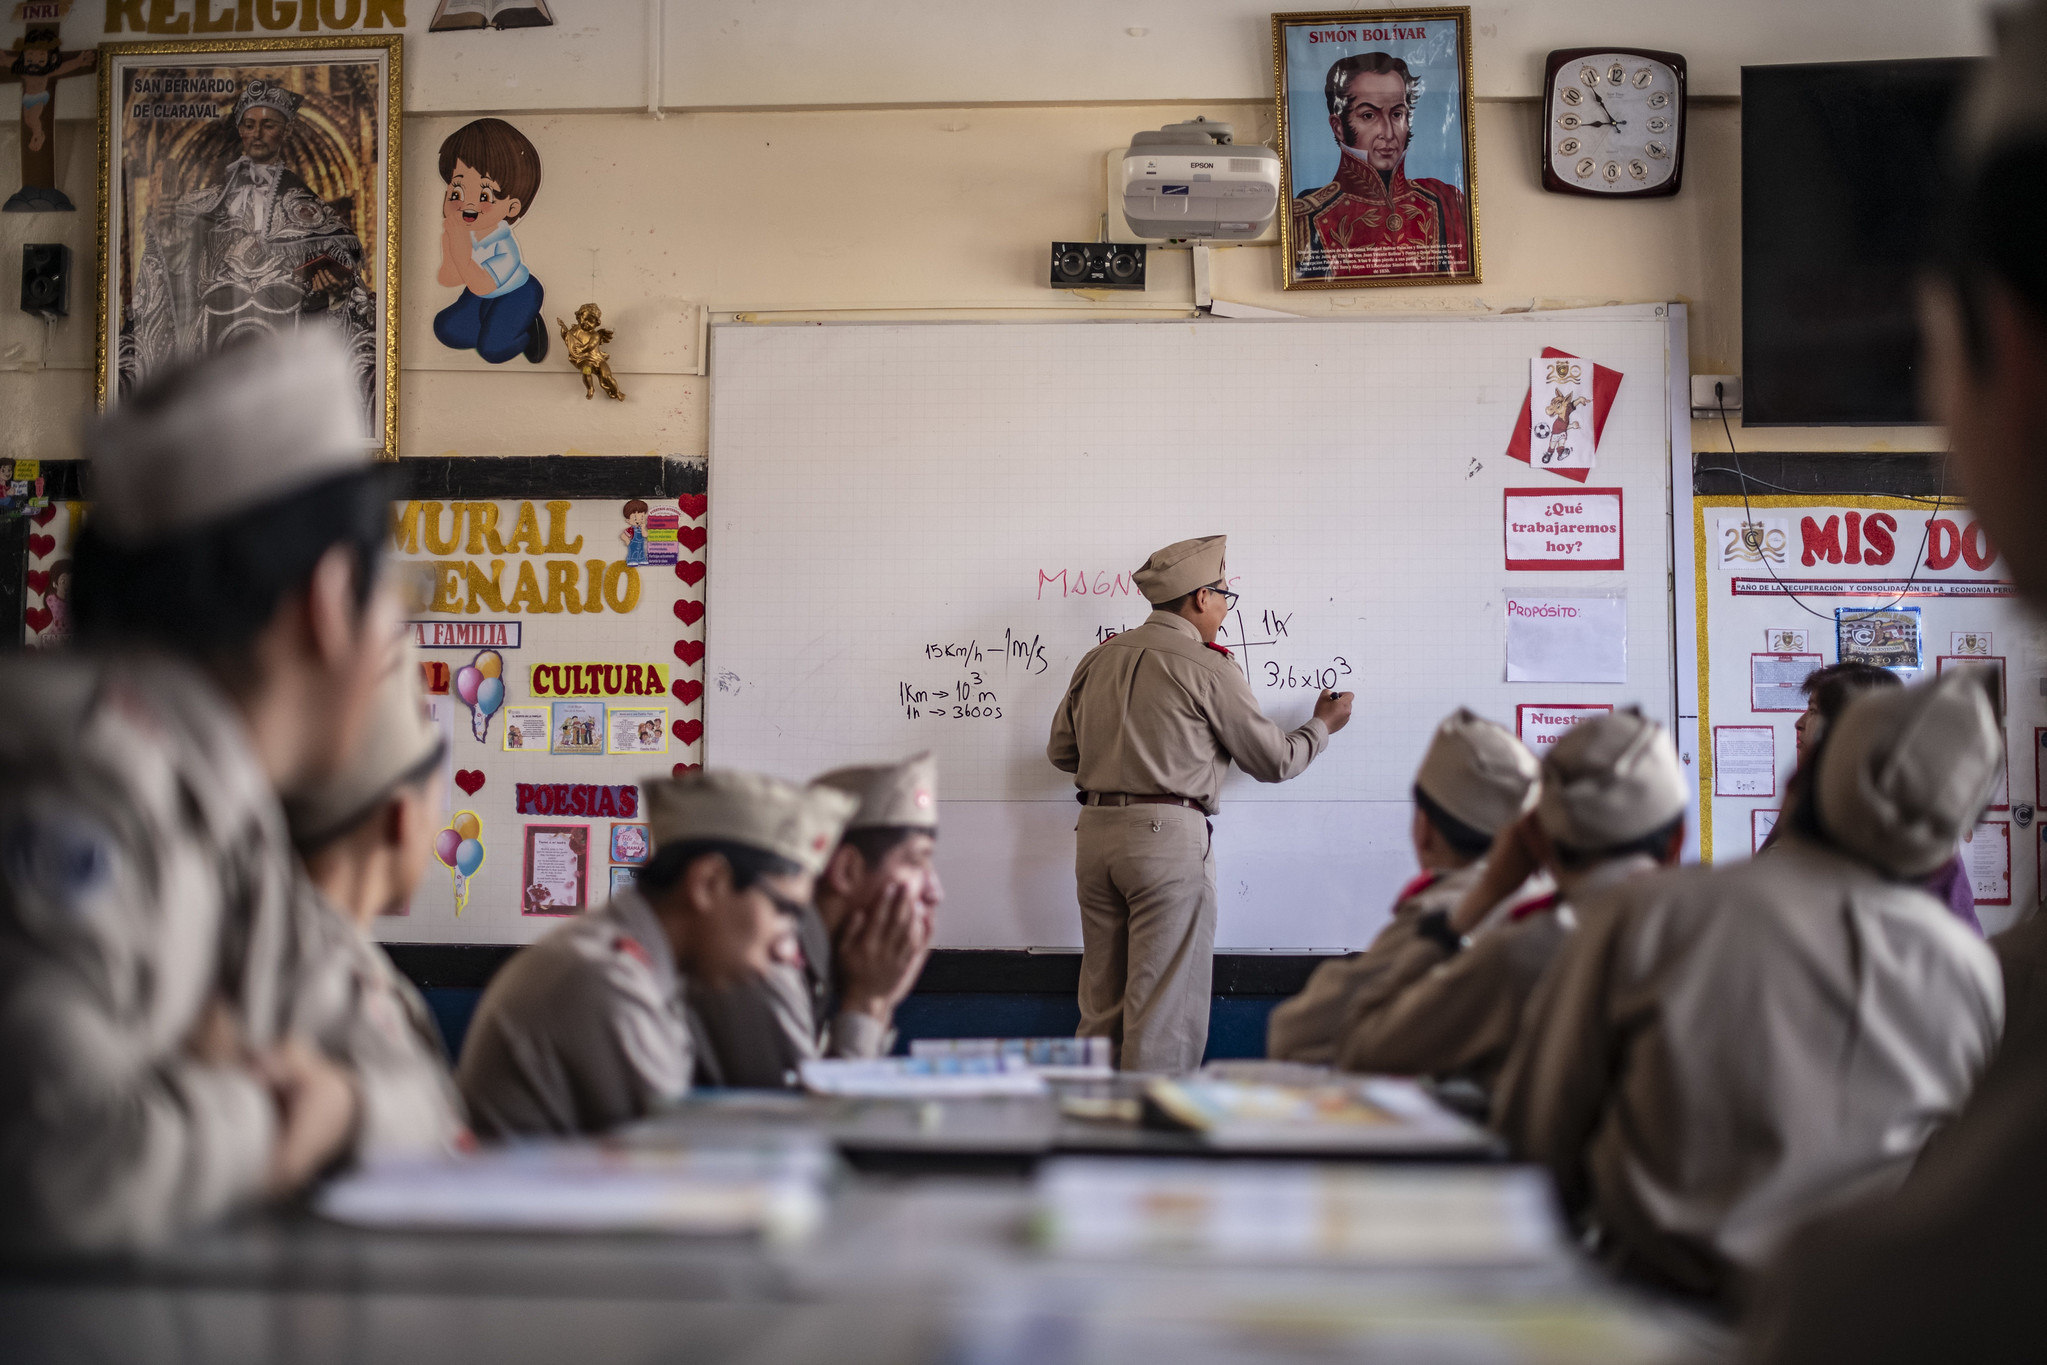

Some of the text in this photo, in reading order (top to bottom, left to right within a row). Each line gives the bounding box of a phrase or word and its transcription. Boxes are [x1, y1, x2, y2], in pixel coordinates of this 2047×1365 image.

[23, 4, 59, 19] INRI
[1309, 24, 1427, 43] SIMÓN BOLÍVAR
[1585, 70, 1597, 84] 11
[1611, 68, 1623, 82] 12
[1638, 74, 1647, 85] 1
[134, 78, 234, 93] SAN BERNARDO
[1566, 89, 1580, 103] 10
[1651, 95, 1665, 106] 2
[133, 104, 220, 118] DE CLARAVAL
[1565, 117, 1577, 126] 9
[1650, 120, 1664, 129] 3
[1564, 141, 1577, 152] 8
[1650, 144, 1661, 155] 4
[1582, 160, 1593, 173] 7
[1608, 164, 1616, 177] 6
[1632, 162, 1643, 175] 5
[1545, 503, 1583, 516] ¿Qué
[386, 500, 584, 555] MURAL
[1511, 522, 1617, 535] trabajaremos
[1545, 541, 1583, 554] hoy?
[1801, 511, 2000, 571] MIS DO
[1950, 585, 1991, 593] ECONOMÍA
[433, 623, 508, 645] FAMILIA
[532, 664, 666, 695] CULTURA
[517, 783, 638, 817] POESIAS
